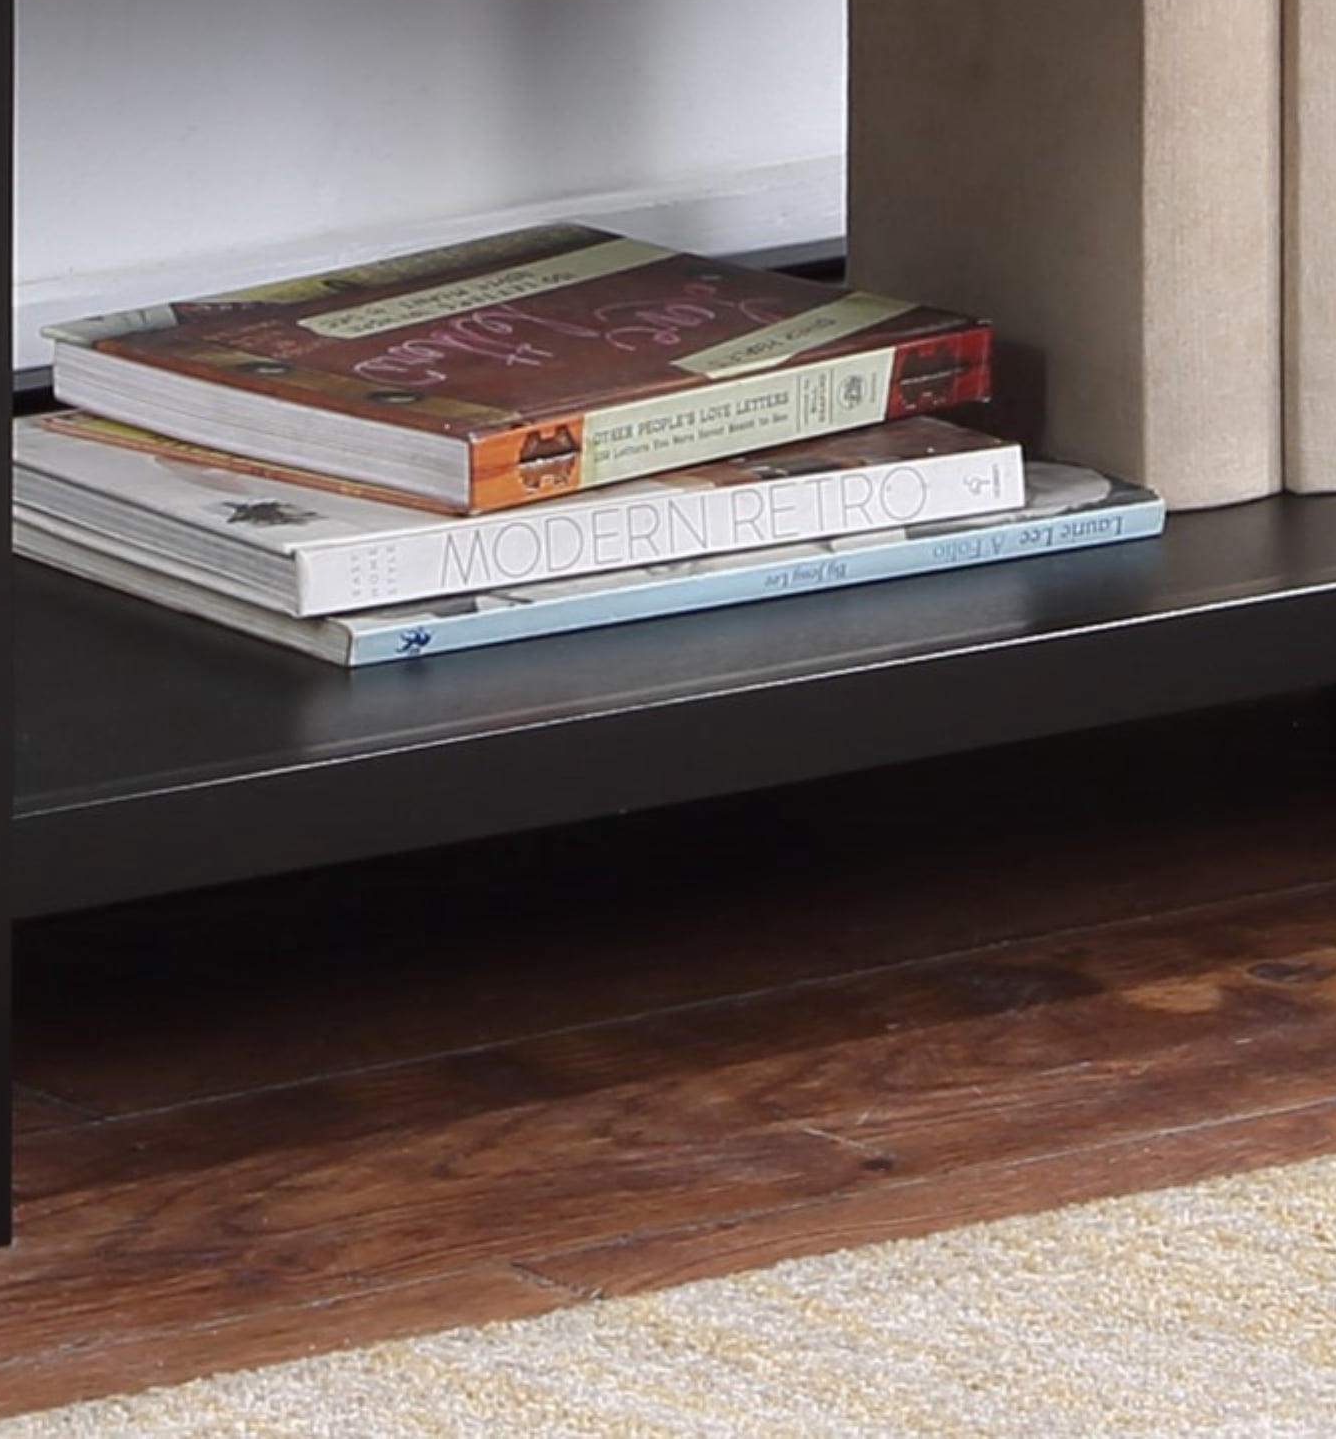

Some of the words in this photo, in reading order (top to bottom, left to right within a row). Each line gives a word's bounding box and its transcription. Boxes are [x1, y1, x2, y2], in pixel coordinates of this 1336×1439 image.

[592, 423, 634, 446] OTHER
[637, 410, 696, 437] PEOPLE'S
[699, 401, 732, 426] LOVE
[736, 390, 791, 415] LETTERS
[441, 497, 709, 587] MODERN
[732, 466, 929, 539] RETRO
[1018, 525, 1054, 551] Lee
[1059, 516, 1125, 542] Laurie
[931, 538, 983, 562] Folio
[989, 534, 1006, 557] A
[763, 570, 791, 590] Lee
[827, 560, 849, 580] By
